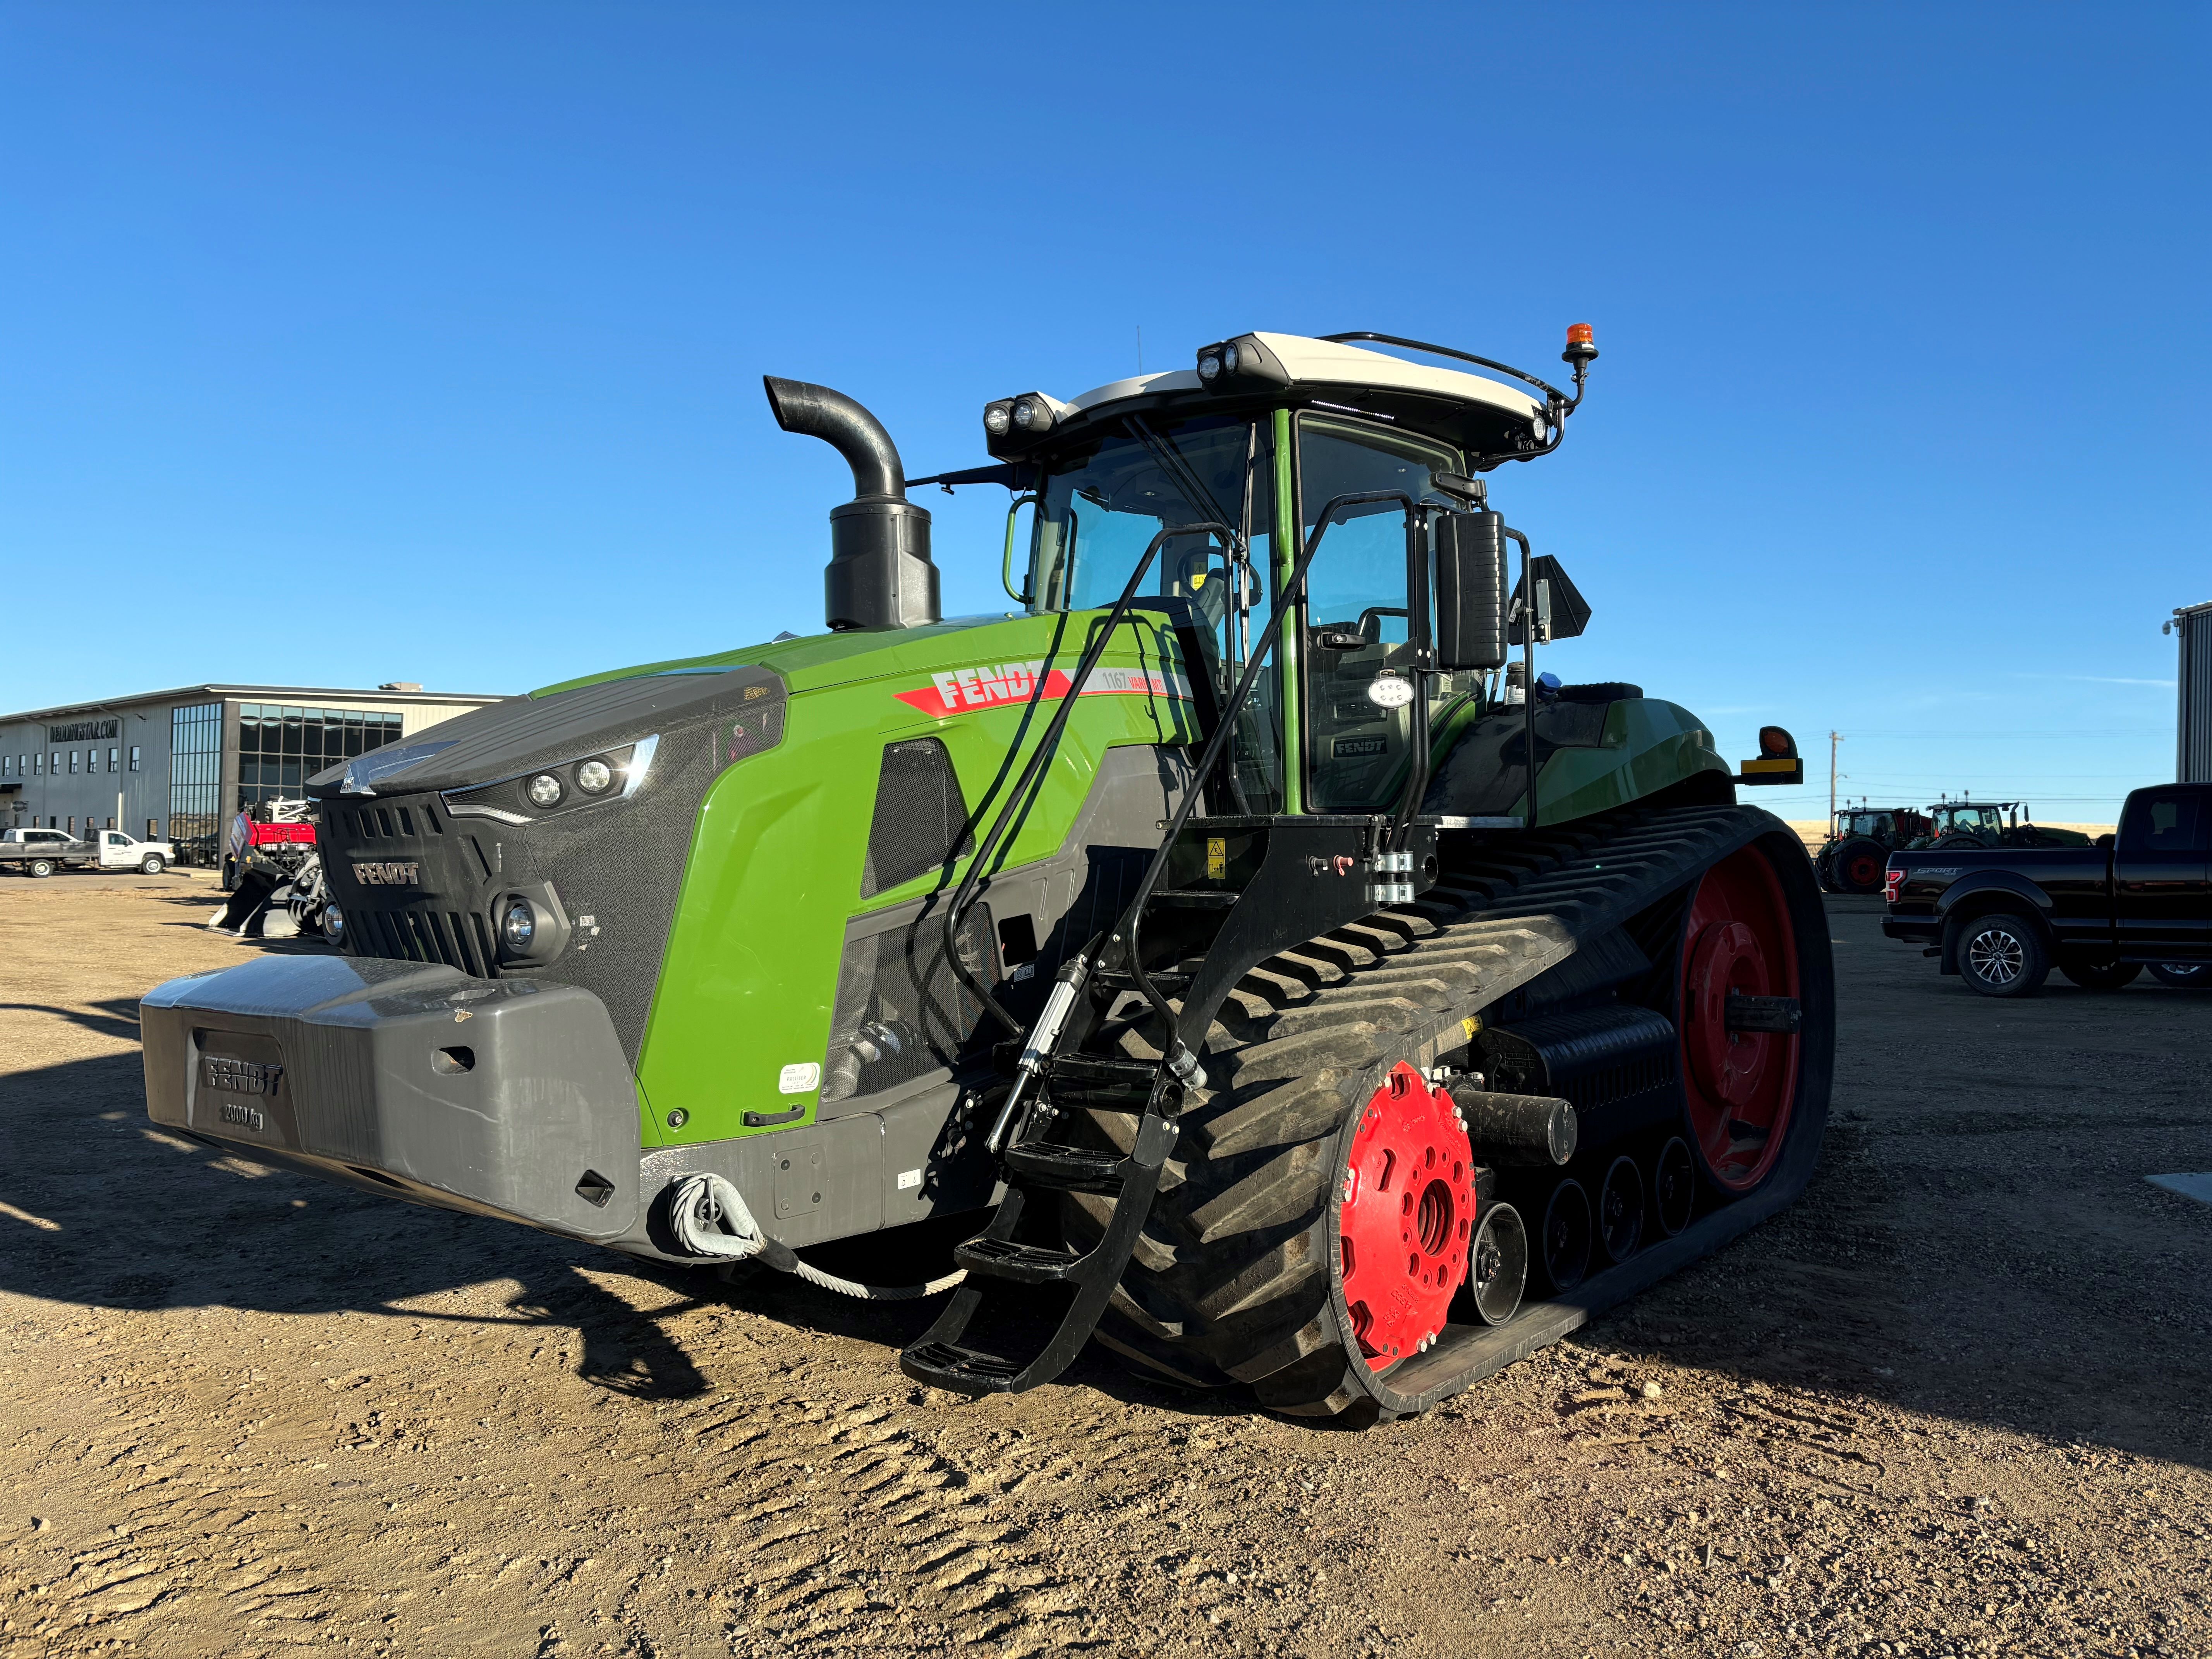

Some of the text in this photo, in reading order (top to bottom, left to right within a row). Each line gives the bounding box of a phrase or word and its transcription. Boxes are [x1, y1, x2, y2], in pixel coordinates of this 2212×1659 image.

[931, 659, 1044, 708] FENDT
[1102, 672, 1163, 691] 1167 VARI MT
[1336, 740, 1385, 754] FENDT
[352, 862, 419, 885] FENDT
[205, 1056, 283, 1096] FENDT
[226, 1104, 263, 1130] 2000 kg
